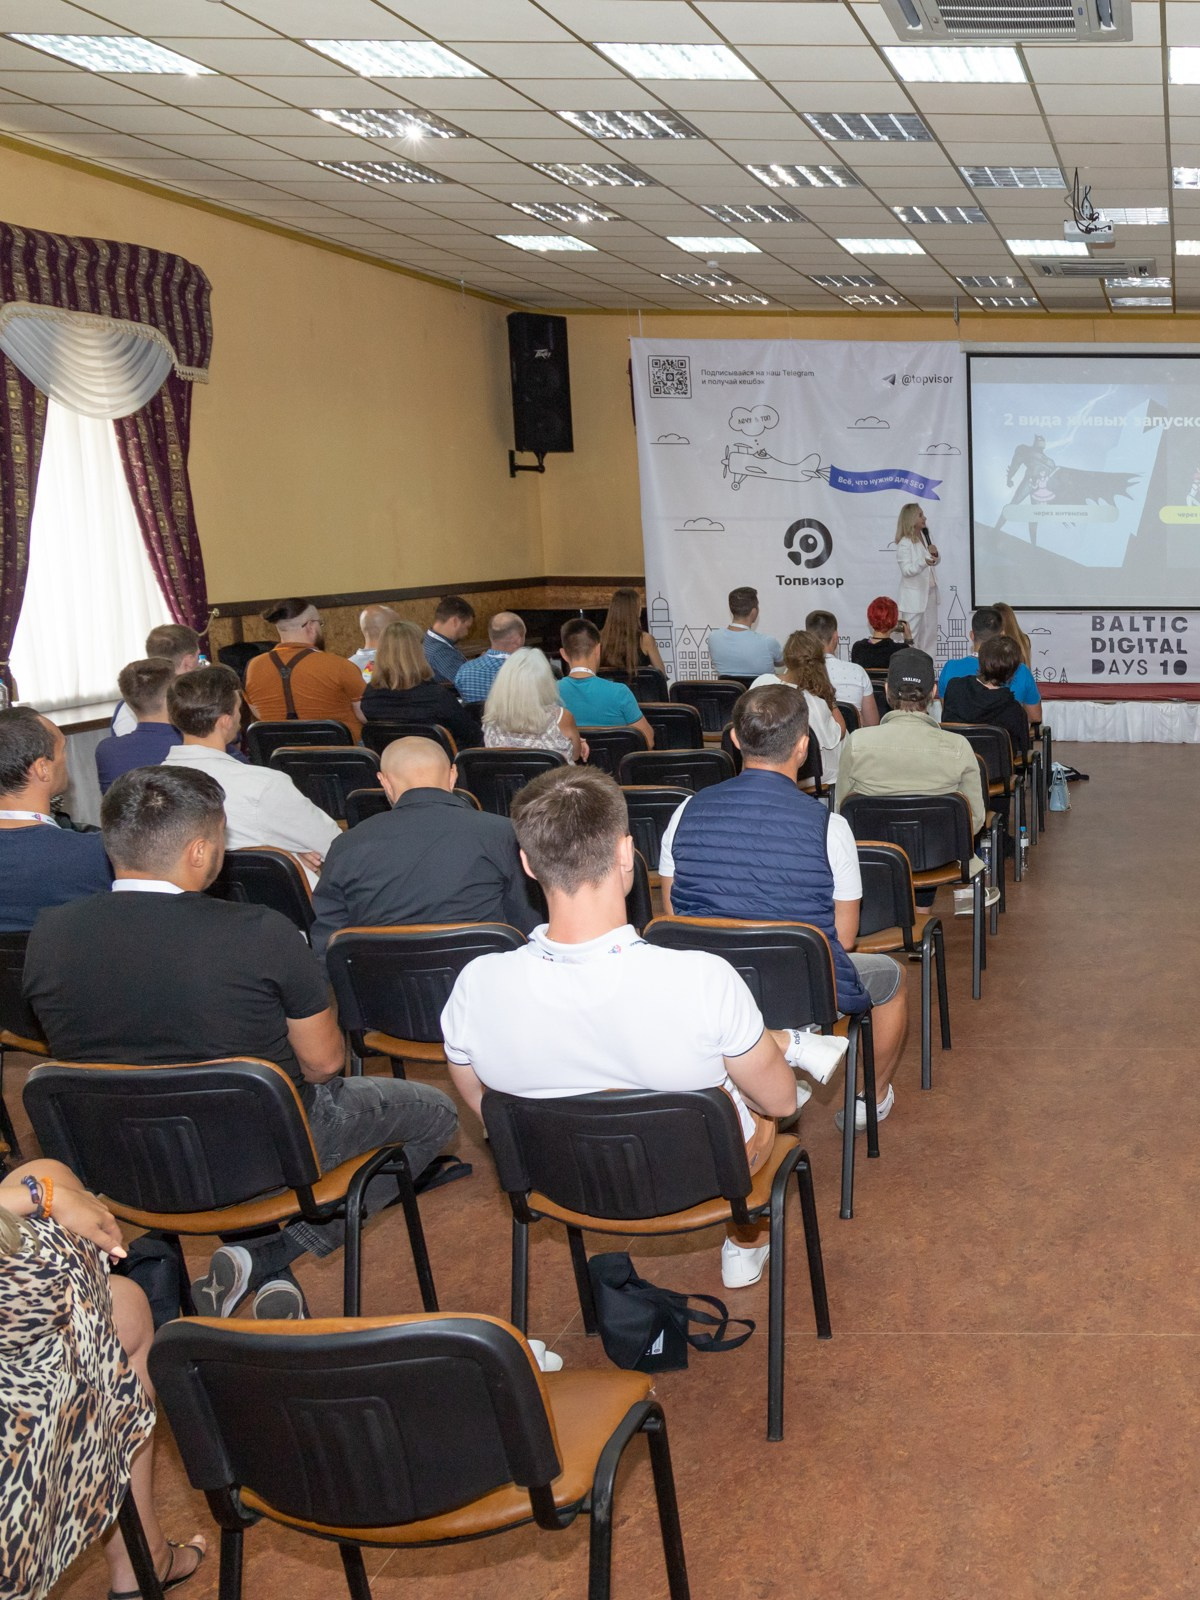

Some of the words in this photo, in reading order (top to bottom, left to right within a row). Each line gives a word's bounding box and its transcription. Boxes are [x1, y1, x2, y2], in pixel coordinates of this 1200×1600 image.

[700, 369, 754, 377] Подписывайся
[782, 369, 815, 378] Telegram
[901, 374, 953, 386] @topvisor
[708, 378, 737, 386] получай
[1003, 413, 1014, 426] 2
[1018, 414, 1061, 428] вида
[1067, 414, 1127, 426] живых
[870, 476, 893, 486] нужно
[894, 476, 909, 484] для
[910, 480, 925, 490] SEO
[775, 574, 844, 588] Топвизор
[1091, 615, 1188, 633] BALTIC
[1090, 637, 1188, 655] DIGITAL
[1091, 659, 1148, 675] DAYS
[1159, 659, 1187, 676] 10
